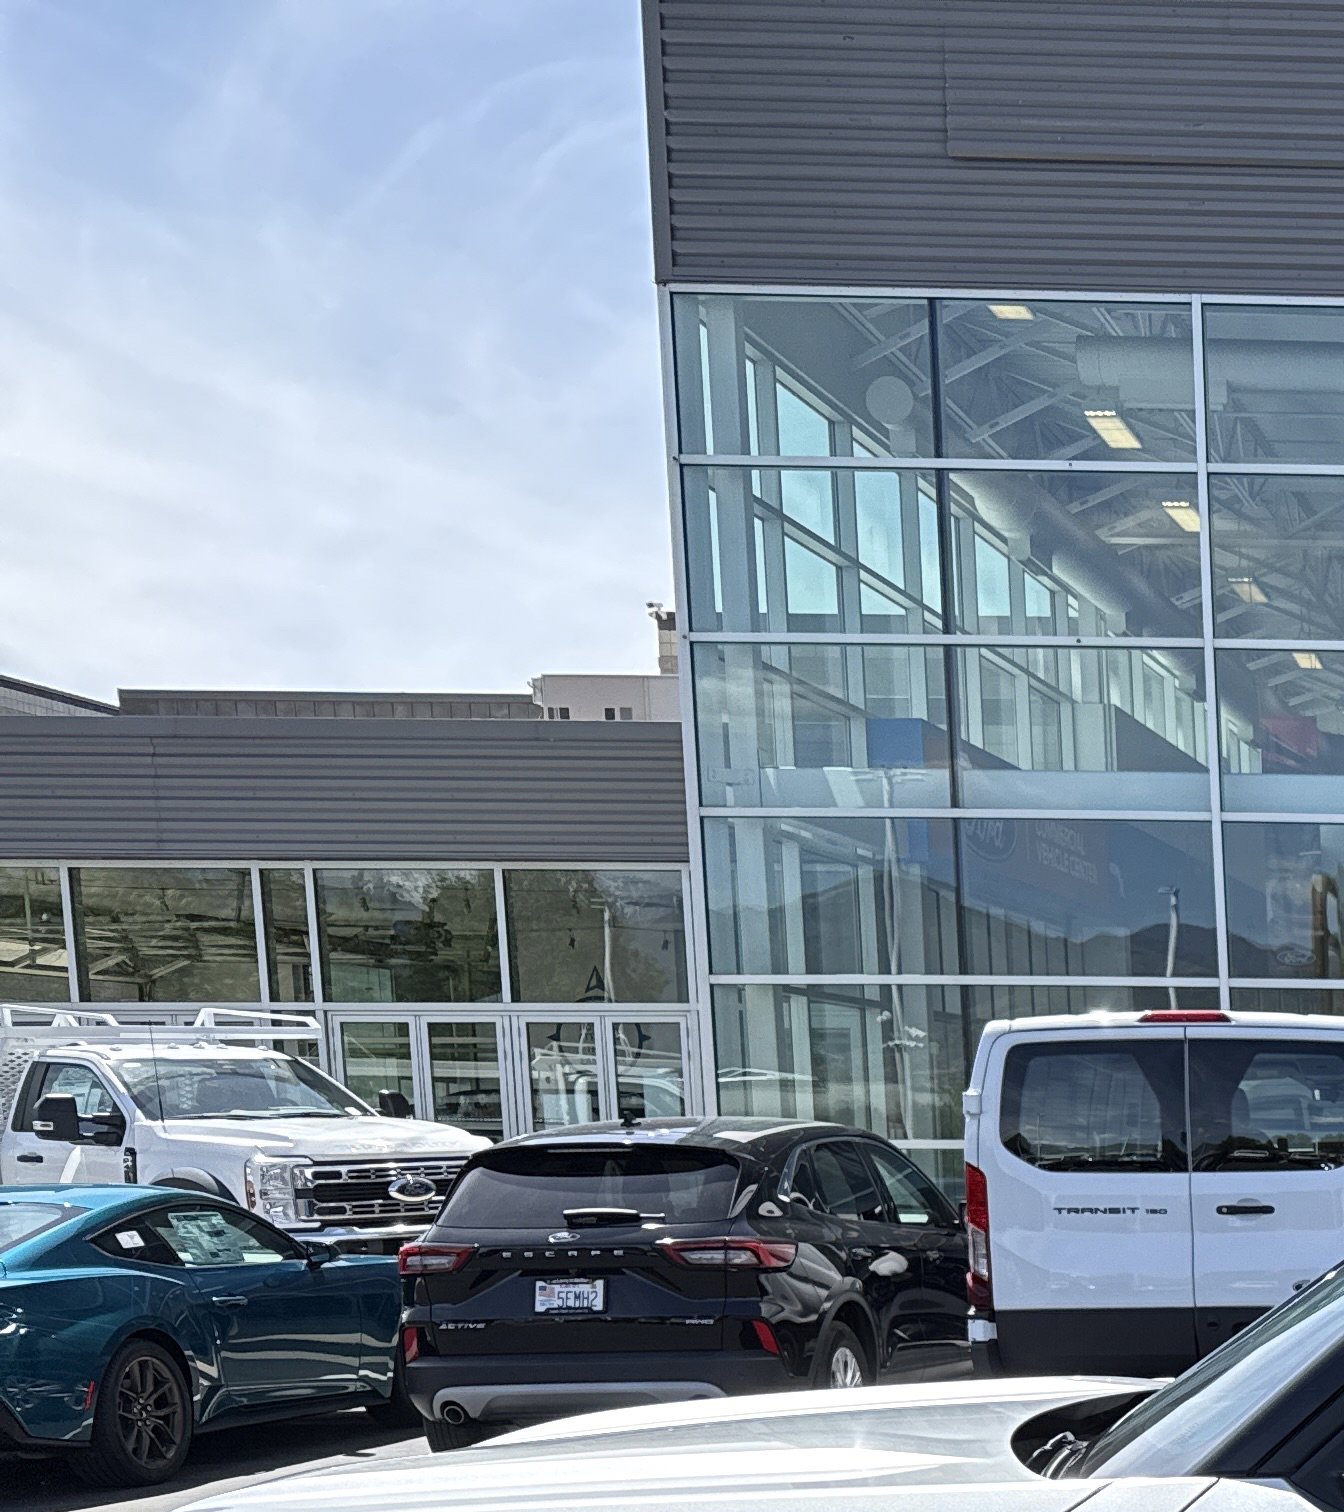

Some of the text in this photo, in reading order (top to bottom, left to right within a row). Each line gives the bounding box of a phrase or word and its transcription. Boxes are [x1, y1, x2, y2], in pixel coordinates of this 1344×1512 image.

[1053, 1207, 1140, 1215] TRANSIT
[502, 1250, 625, 1258] ESCAPE
[439, 1322, 486, 1330] ACTIVE
